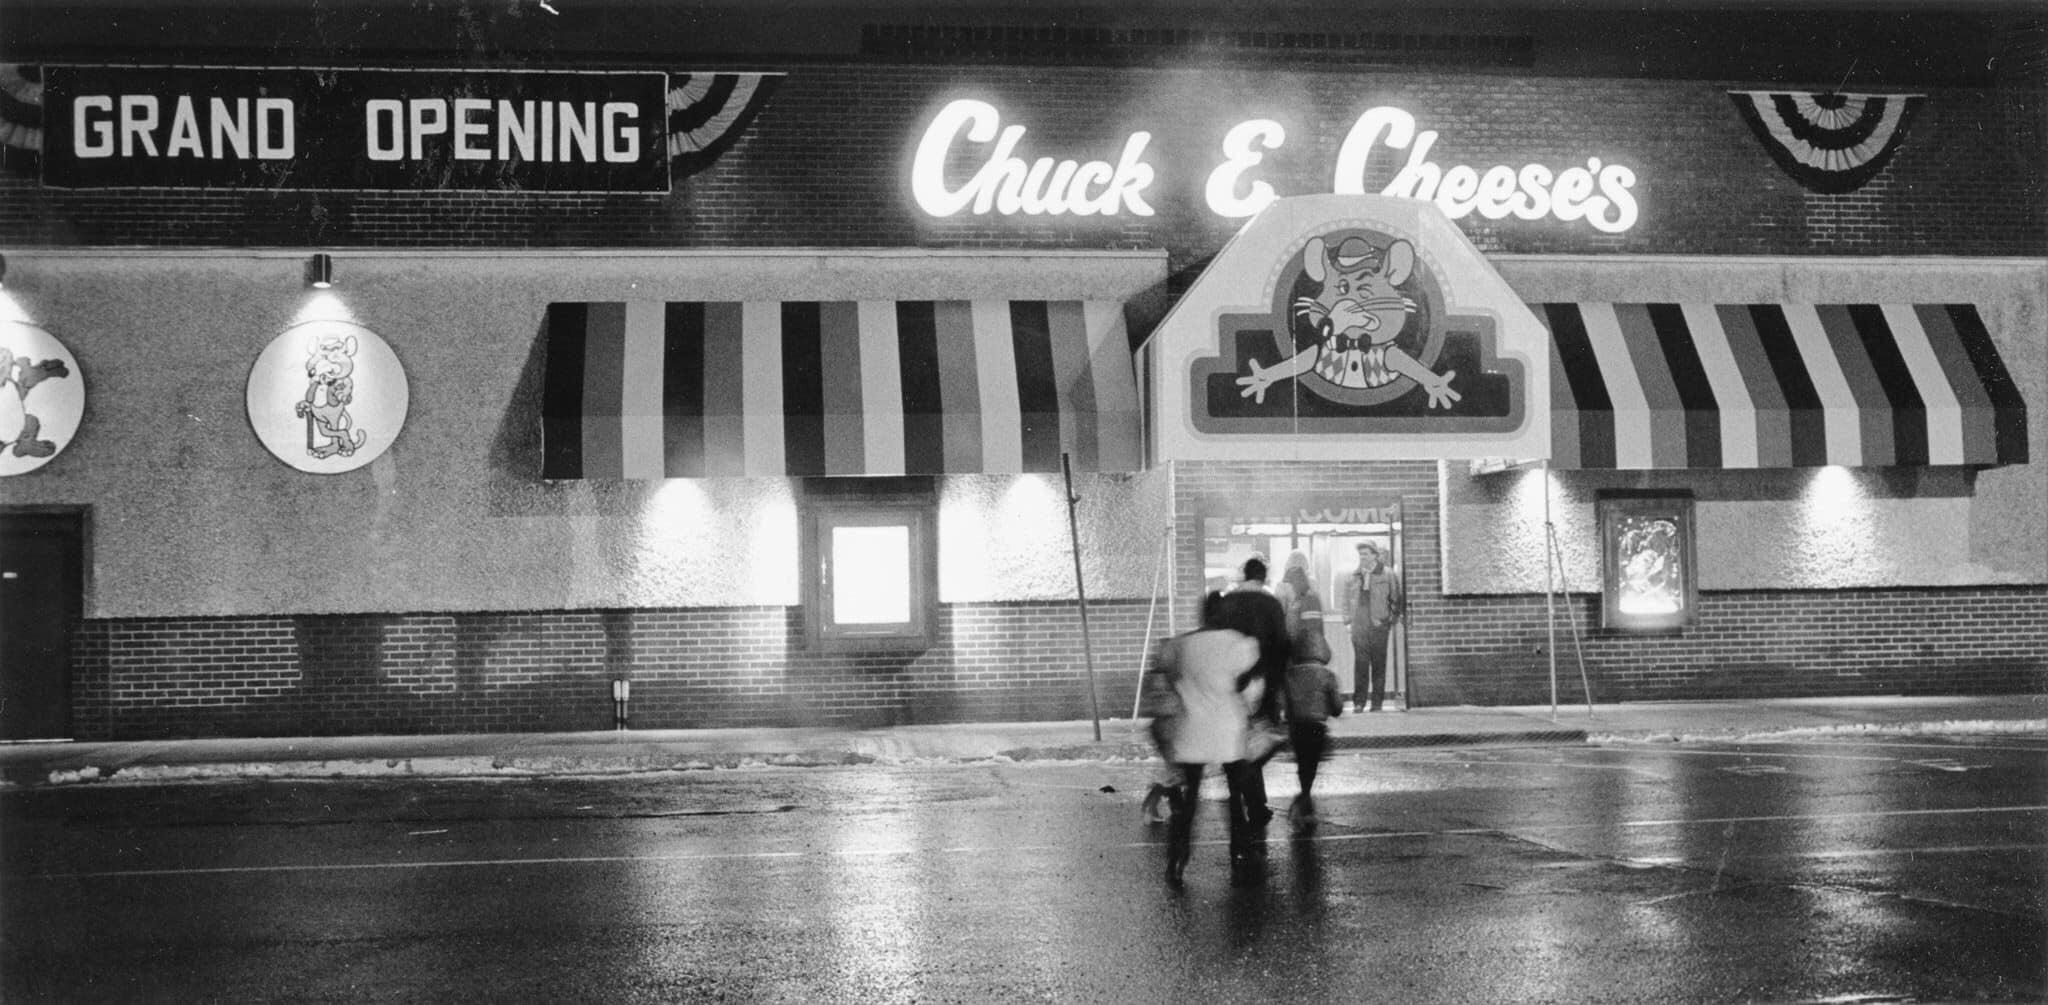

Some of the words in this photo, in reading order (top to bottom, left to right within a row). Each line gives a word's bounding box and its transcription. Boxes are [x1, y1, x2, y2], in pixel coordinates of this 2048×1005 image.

[74, 95, 295, 160] GRAND
[366, 98, 640, 163] OPENING
[912, 99, 1154, 217] Chuck
[1205, 119, 1286, 217] E
[1334, 106, 1638, 233] Cheese's
